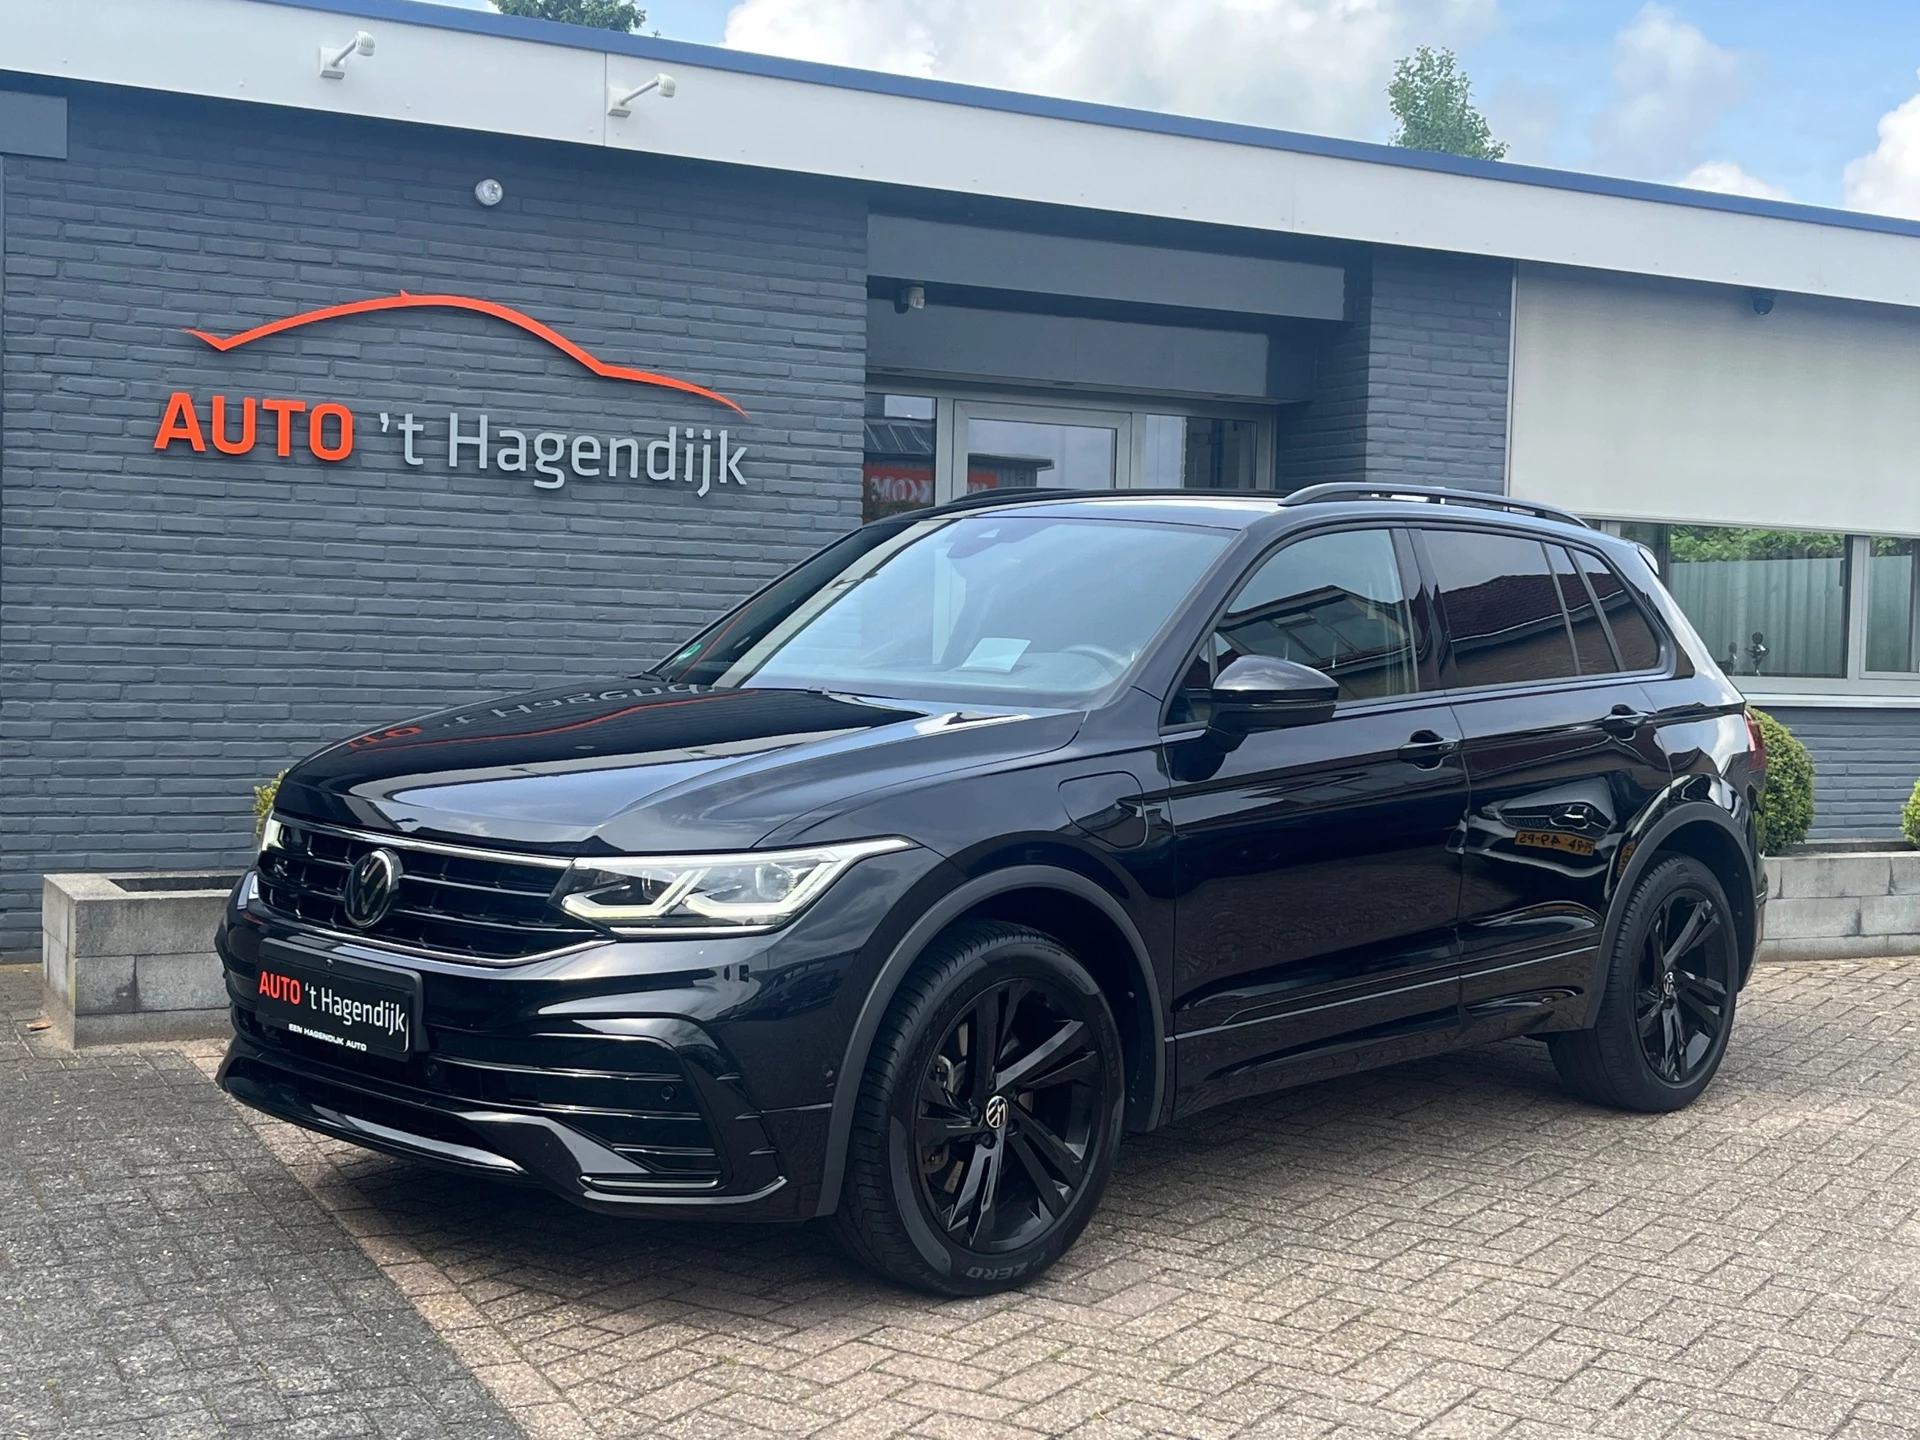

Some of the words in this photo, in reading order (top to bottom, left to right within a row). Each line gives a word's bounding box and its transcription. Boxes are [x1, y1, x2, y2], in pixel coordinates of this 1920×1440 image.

[154, 392, 354, 461] AUTO
[379, 412, 425, 466] 't
[448, 412, 748, 498] Hagendijk
[259, 971, 301, 1005] AUTO
[304, 982, 318, 1010] 't
[320, 987, 406, 1036] Hagendijk
[288, 1023, 303, 1034] EEN
[303, 1027, 345, 1046] HAGENDIJK
[345, 1039, 368, 1052] AUTO
[965, 1261, 1028, 1280] ZERO
